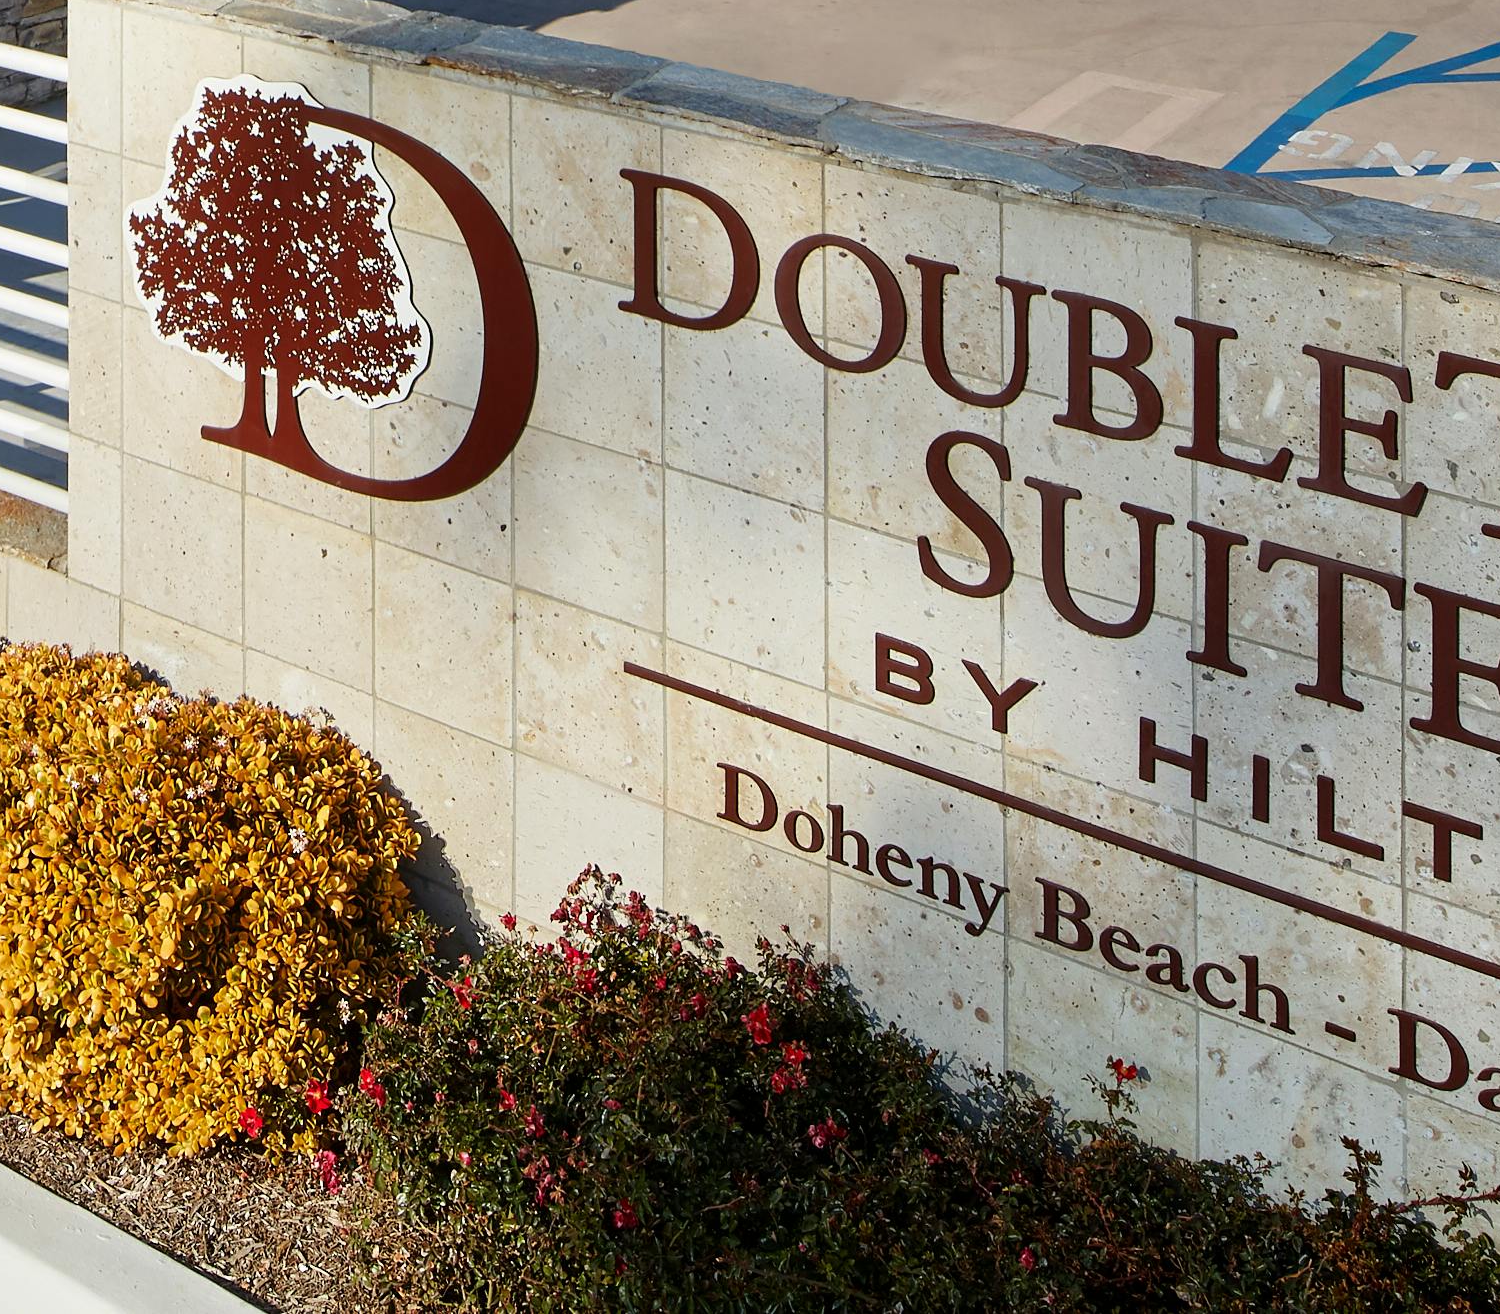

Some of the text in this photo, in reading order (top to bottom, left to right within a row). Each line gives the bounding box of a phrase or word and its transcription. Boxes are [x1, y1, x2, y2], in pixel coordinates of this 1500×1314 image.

[874, 631, 1039, 735] BY
[715, 761, 1008, 938] Doheny
[1034, 875, 1296, 1037] Beach
[1324, 1019, 1358, 1043] -
